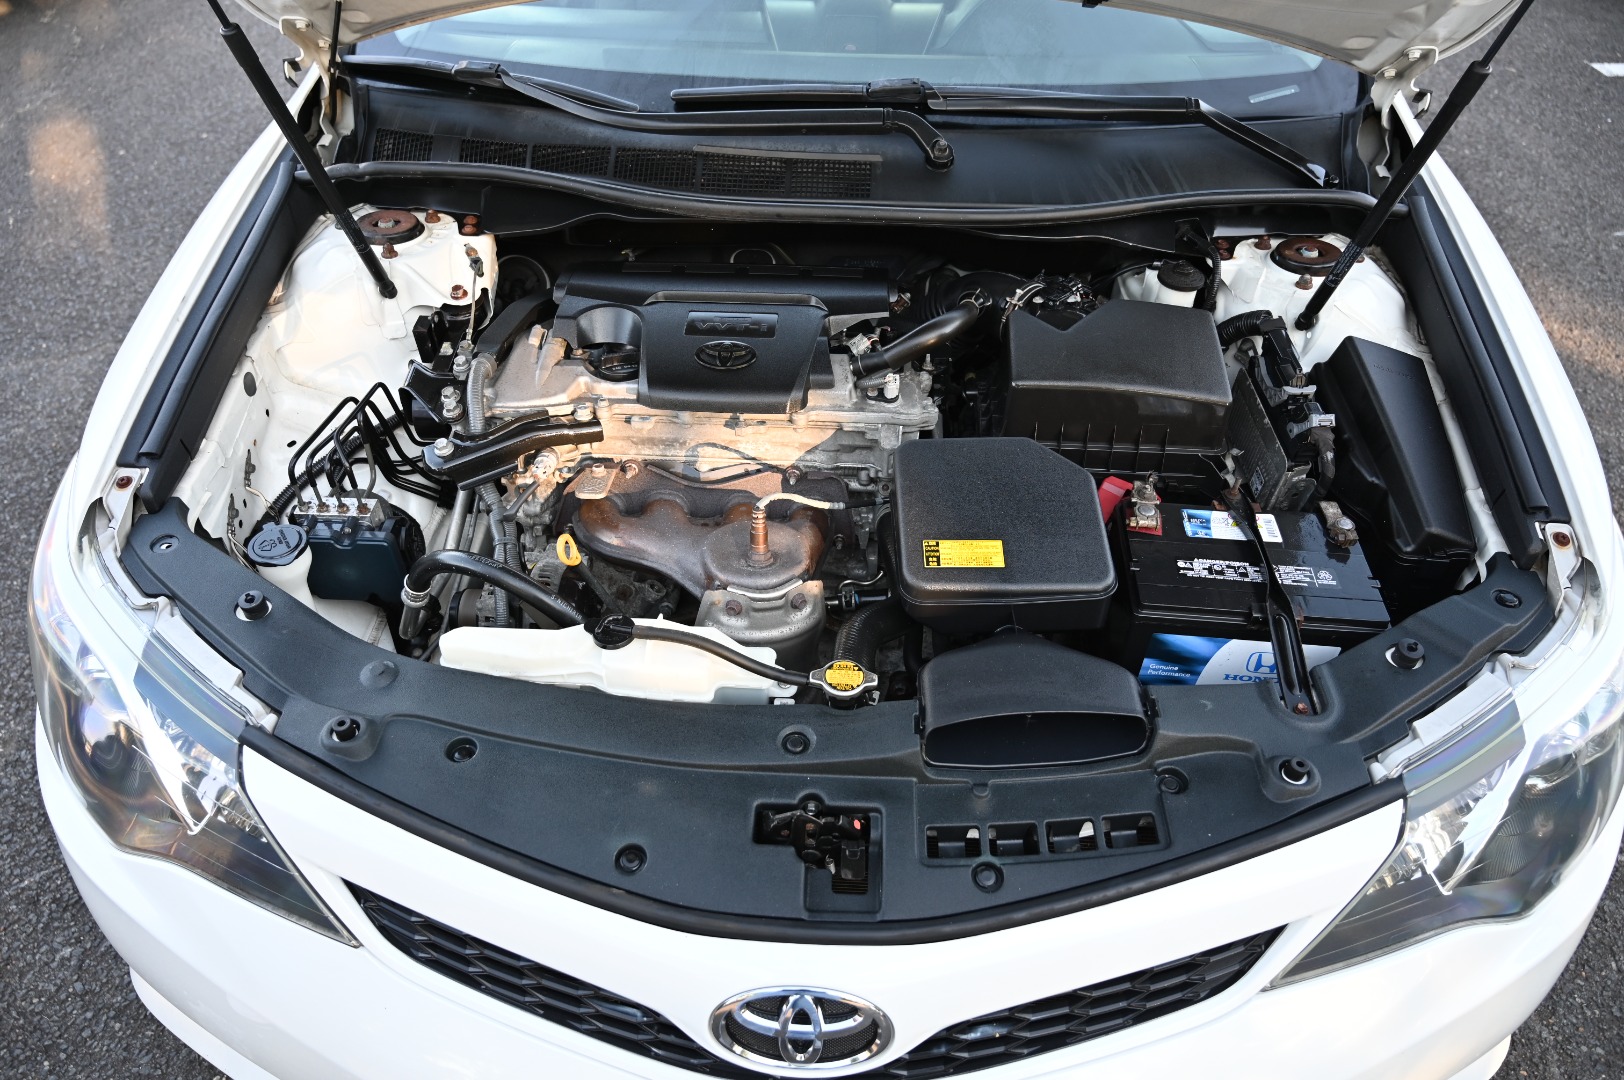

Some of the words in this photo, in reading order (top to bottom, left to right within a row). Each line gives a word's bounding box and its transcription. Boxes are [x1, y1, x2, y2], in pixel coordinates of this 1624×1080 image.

[1149, 663, 1179, 671] Genuine
[1147, 669, 1191, 678] Performance
[1223, 673, 1279, 684] HON
